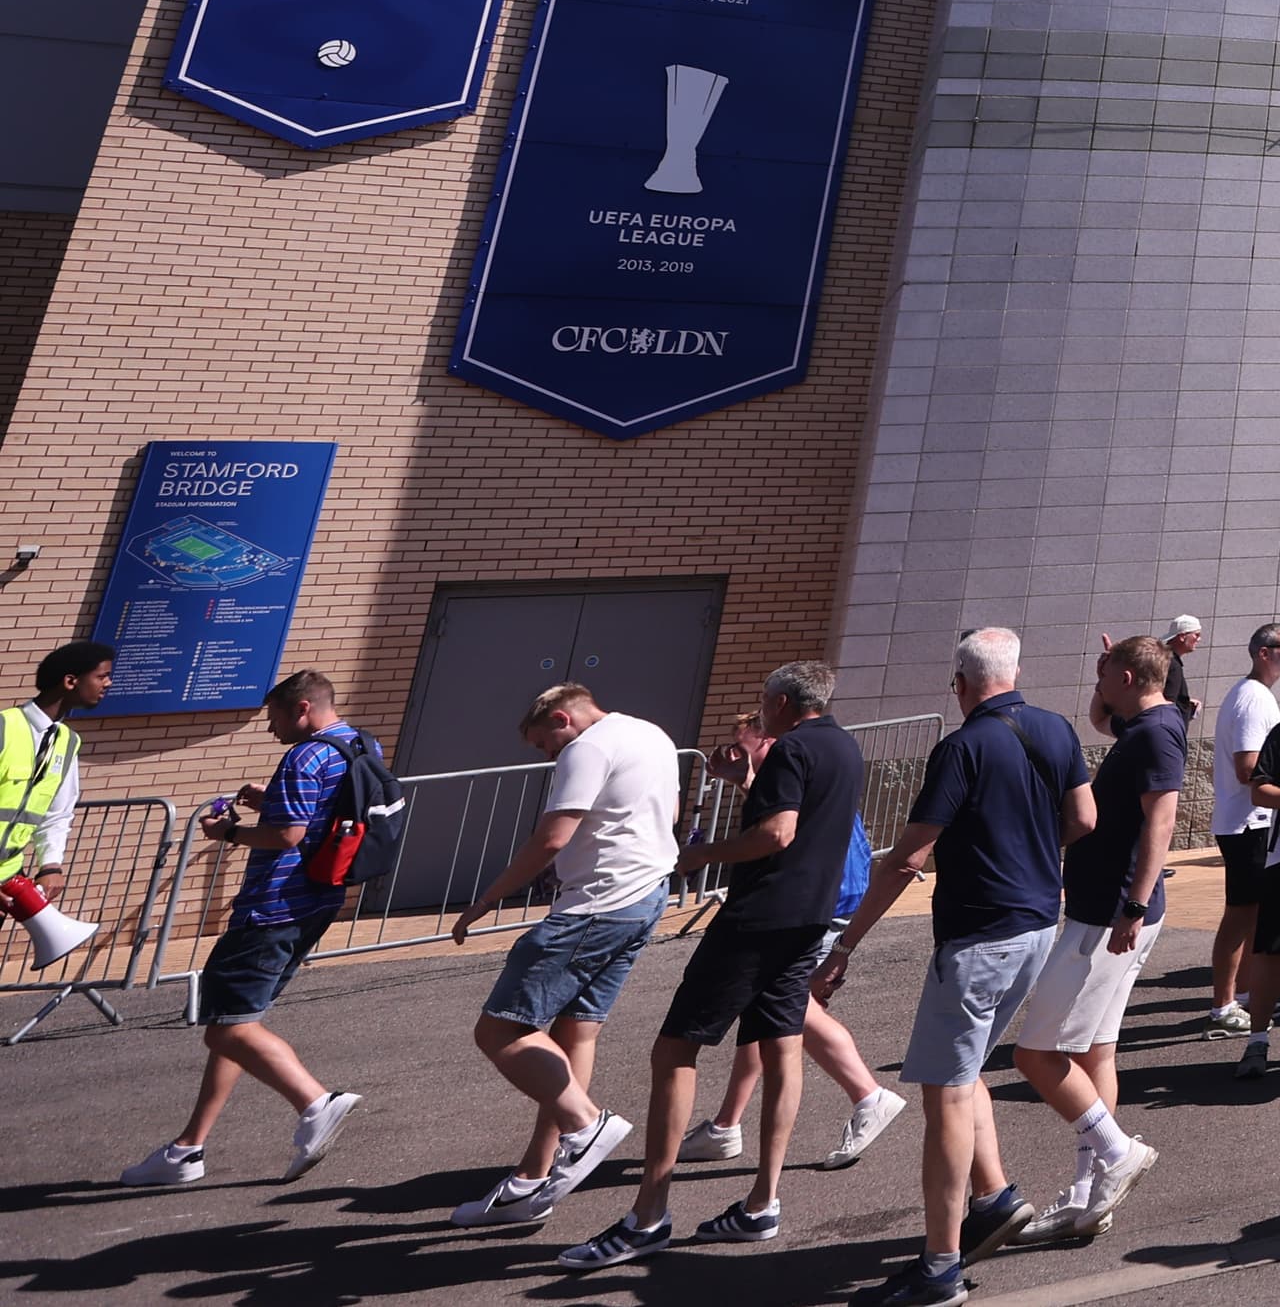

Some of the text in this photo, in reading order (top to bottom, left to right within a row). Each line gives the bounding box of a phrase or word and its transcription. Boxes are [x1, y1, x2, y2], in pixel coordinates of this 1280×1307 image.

[588, 209, 737, 233] UEFA EUROPA
[618, 229, 706, 247] LEAGUE
[617, 258, 694, 274] 2013, 2019
[163, 462, 298, 478] STAMFORD
[158, 480, 254, 496] BRIDGE
